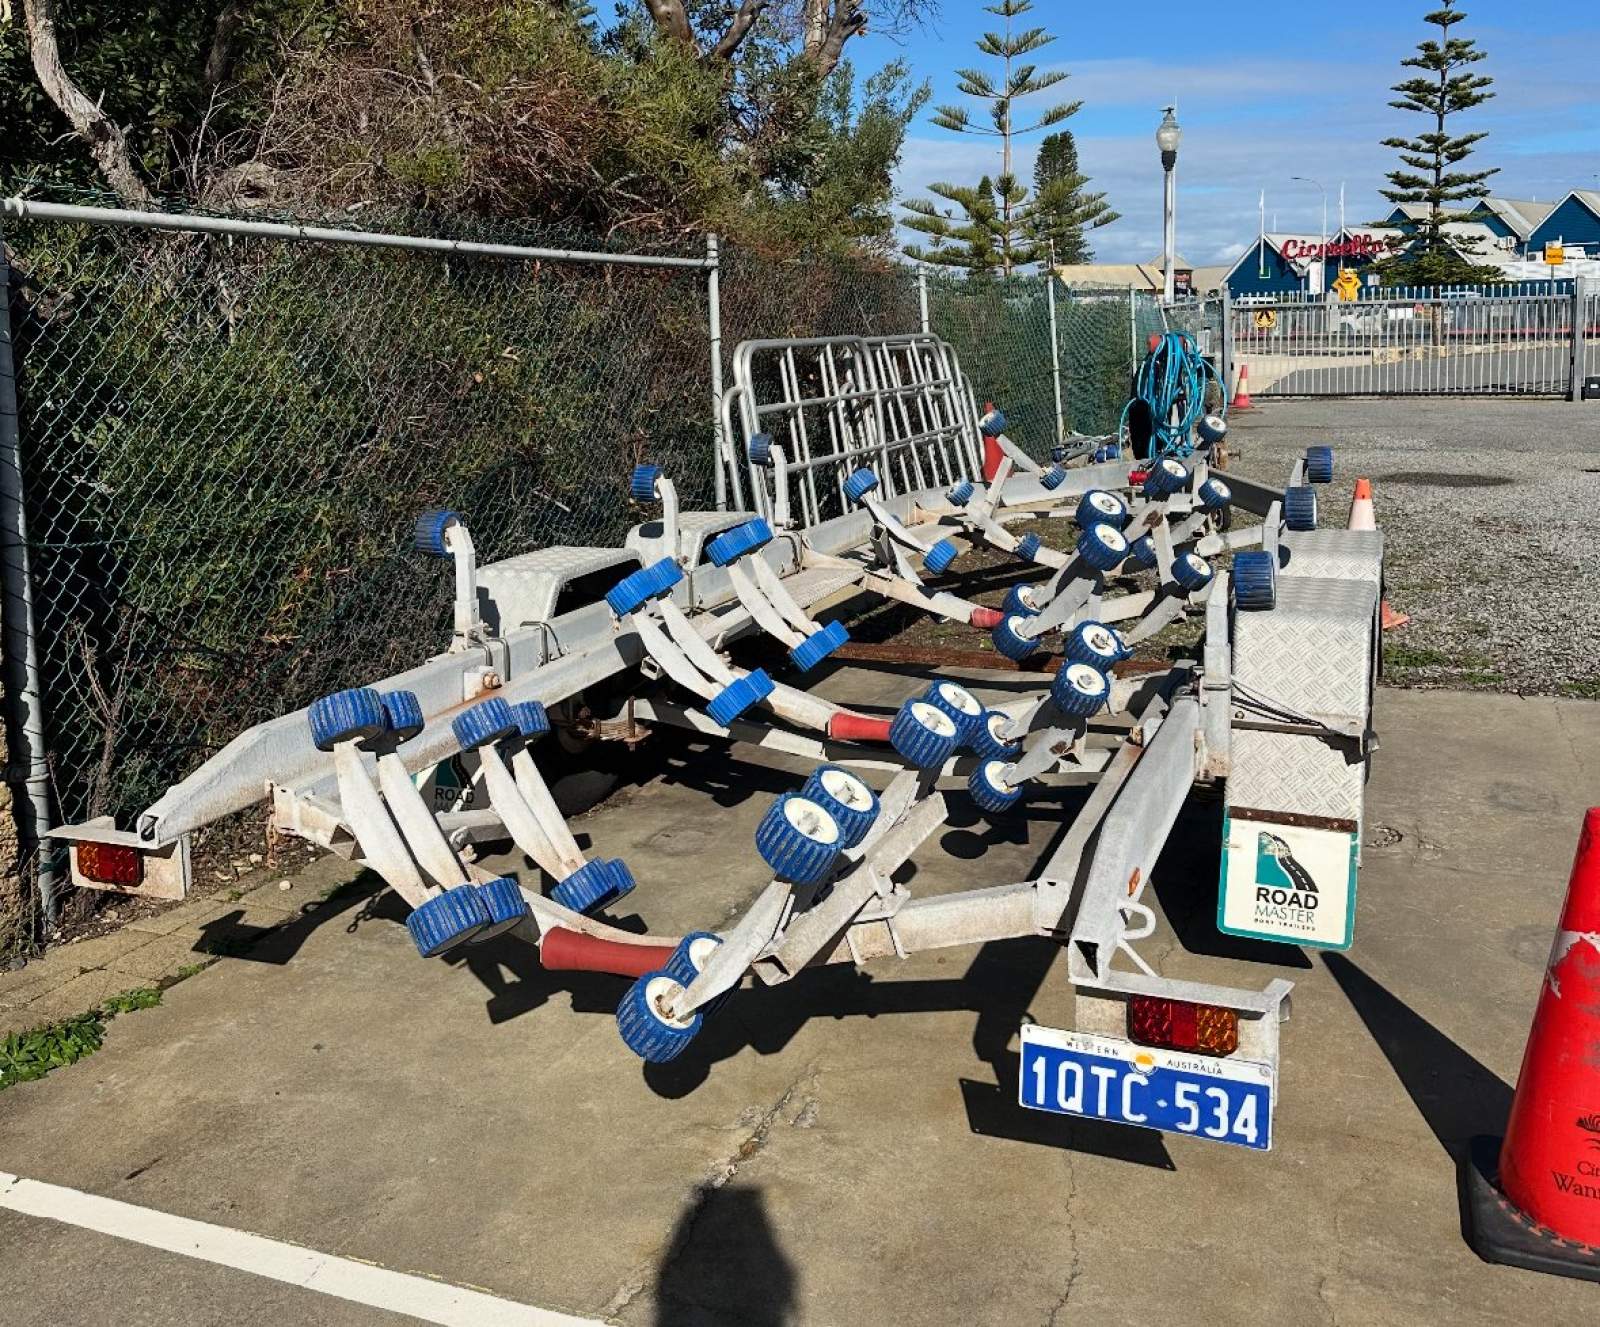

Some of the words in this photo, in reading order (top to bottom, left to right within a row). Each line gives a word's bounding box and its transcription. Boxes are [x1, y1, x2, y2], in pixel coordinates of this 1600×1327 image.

[1256, 887, 1319, 910] ROAD
[1254, 904, 1315, 925] MASTER
[1166, 1058, 1223, 1076] AUSTRALIA
[1551, 1169, 1600, 1200] Wan
